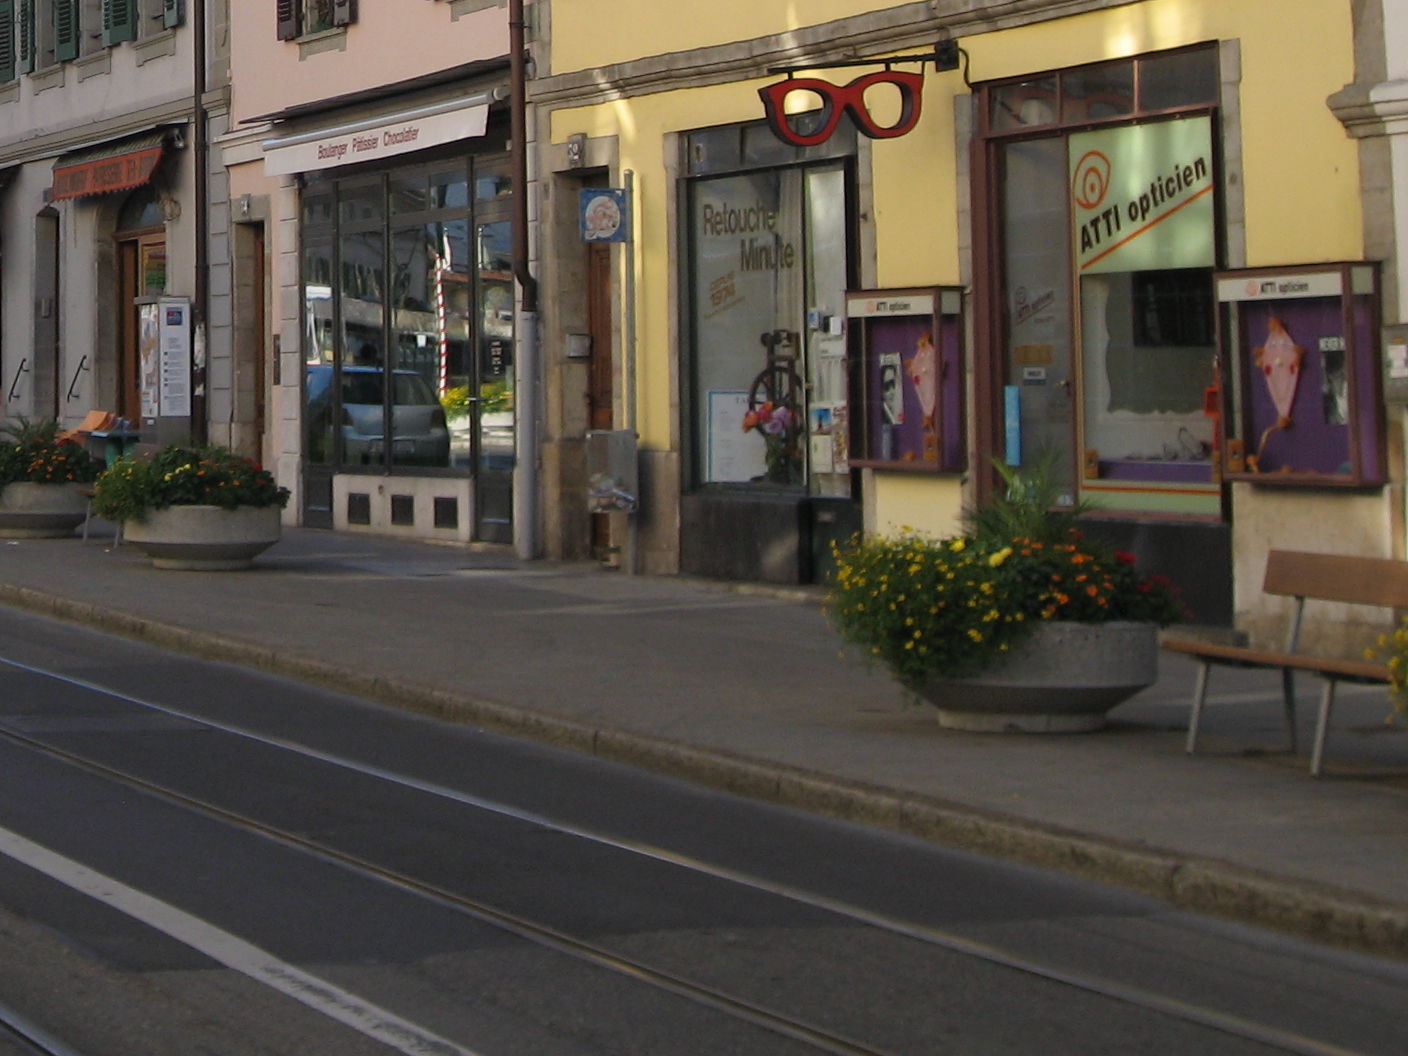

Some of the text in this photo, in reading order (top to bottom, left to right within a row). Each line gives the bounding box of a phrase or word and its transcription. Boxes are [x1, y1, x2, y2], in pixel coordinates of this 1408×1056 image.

[317, 126, 420, 160] Boulanger Pâtissier Chocolatier
[703, 199, 776, 236] Retouche
[1080, 157, 1207, 254] ATTI opticien
[739, 238, 794, 271] Minute
[1260, 281, 1309, 295] ATTI opticien
[876, 301, 911, 313] ATTI opticien
